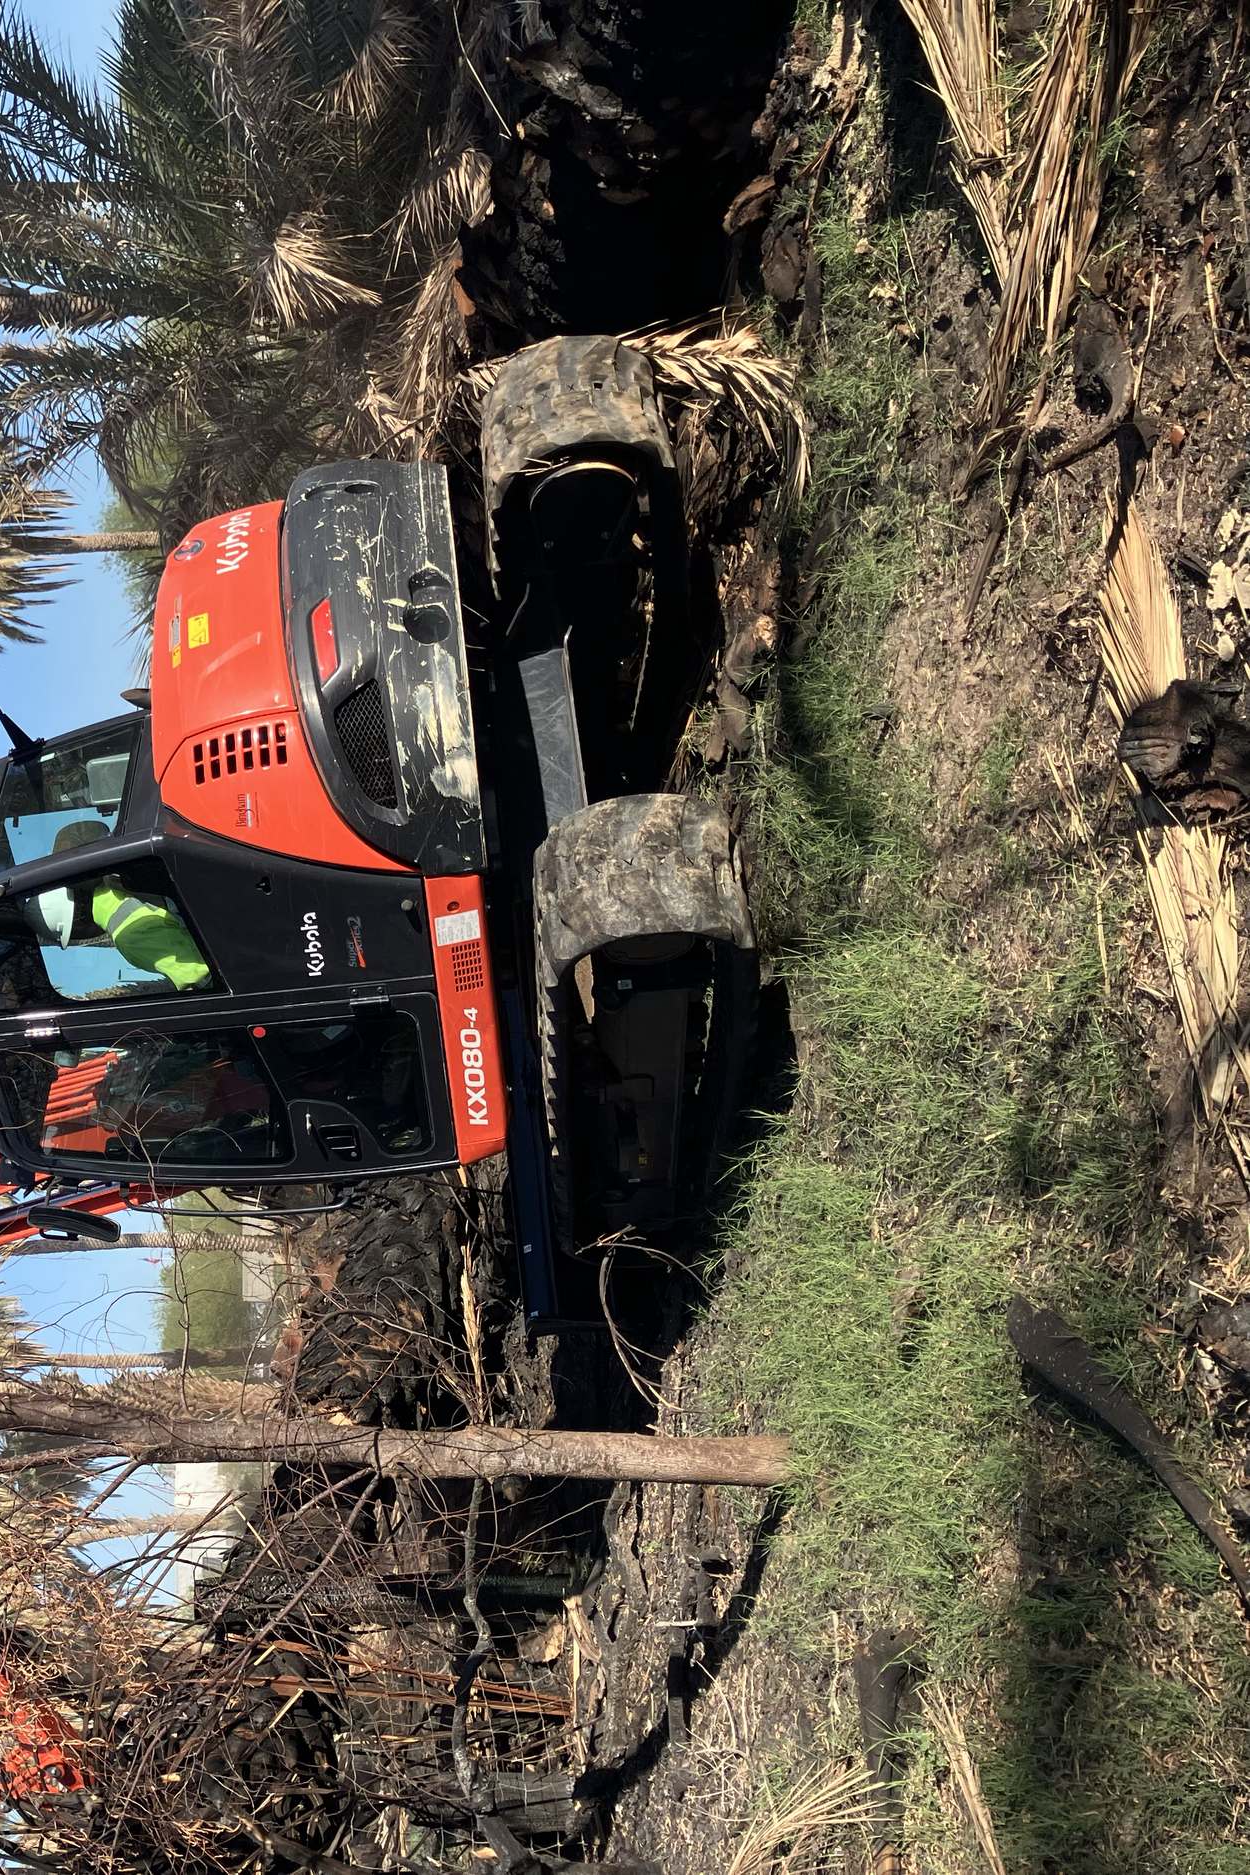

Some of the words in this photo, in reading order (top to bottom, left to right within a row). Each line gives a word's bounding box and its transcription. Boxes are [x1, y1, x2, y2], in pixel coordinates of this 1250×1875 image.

[216, 511, 252, 575] Kubota
[234, 794, 255, 827] Bingham
[300, 912, 325, 976] Kubota
[346, 939, 358, 967] Super
[460, 1007, 488, 1125] KX080-4
